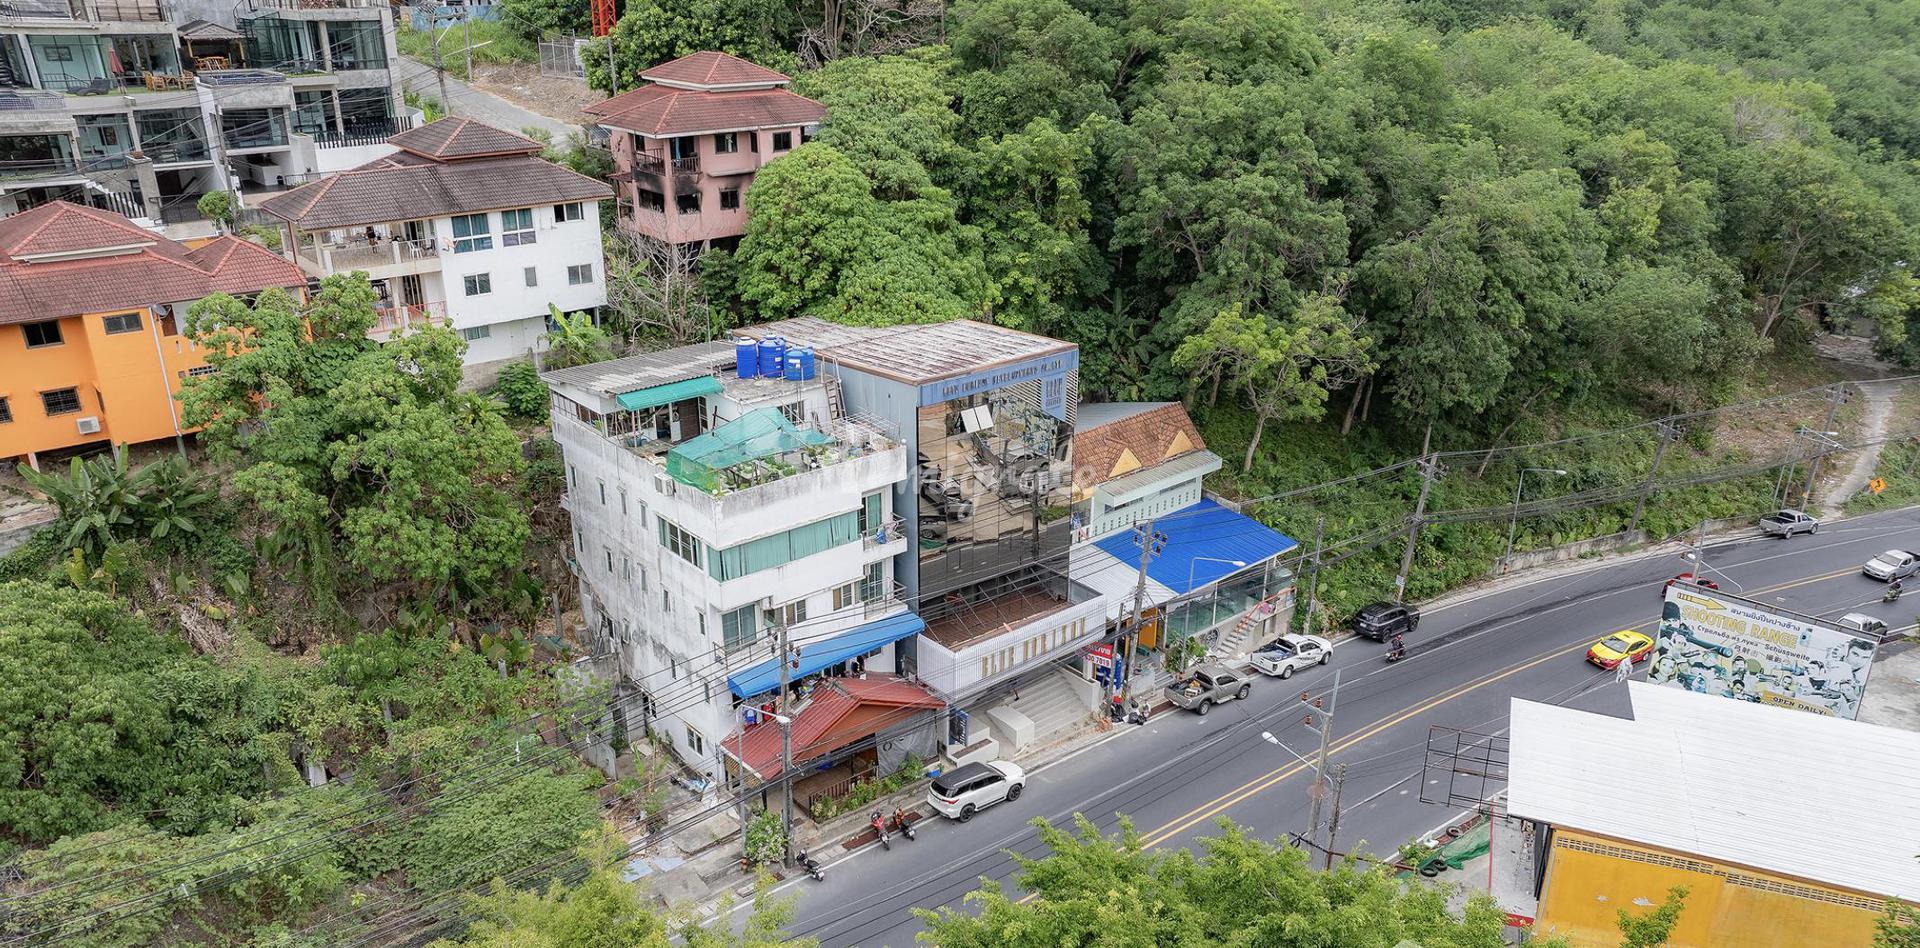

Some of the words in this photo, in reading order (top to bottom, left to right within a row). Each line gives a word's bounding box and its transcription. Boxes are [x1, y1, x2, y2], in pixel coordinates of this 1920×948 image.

[1681, 604, 1746, 633] SHOOTING
[1750, 624, 1799, 649] RANGE
[1764, 643, 1811, 661] Schussweite
[1772, 696, 1795, 707] OPEN
